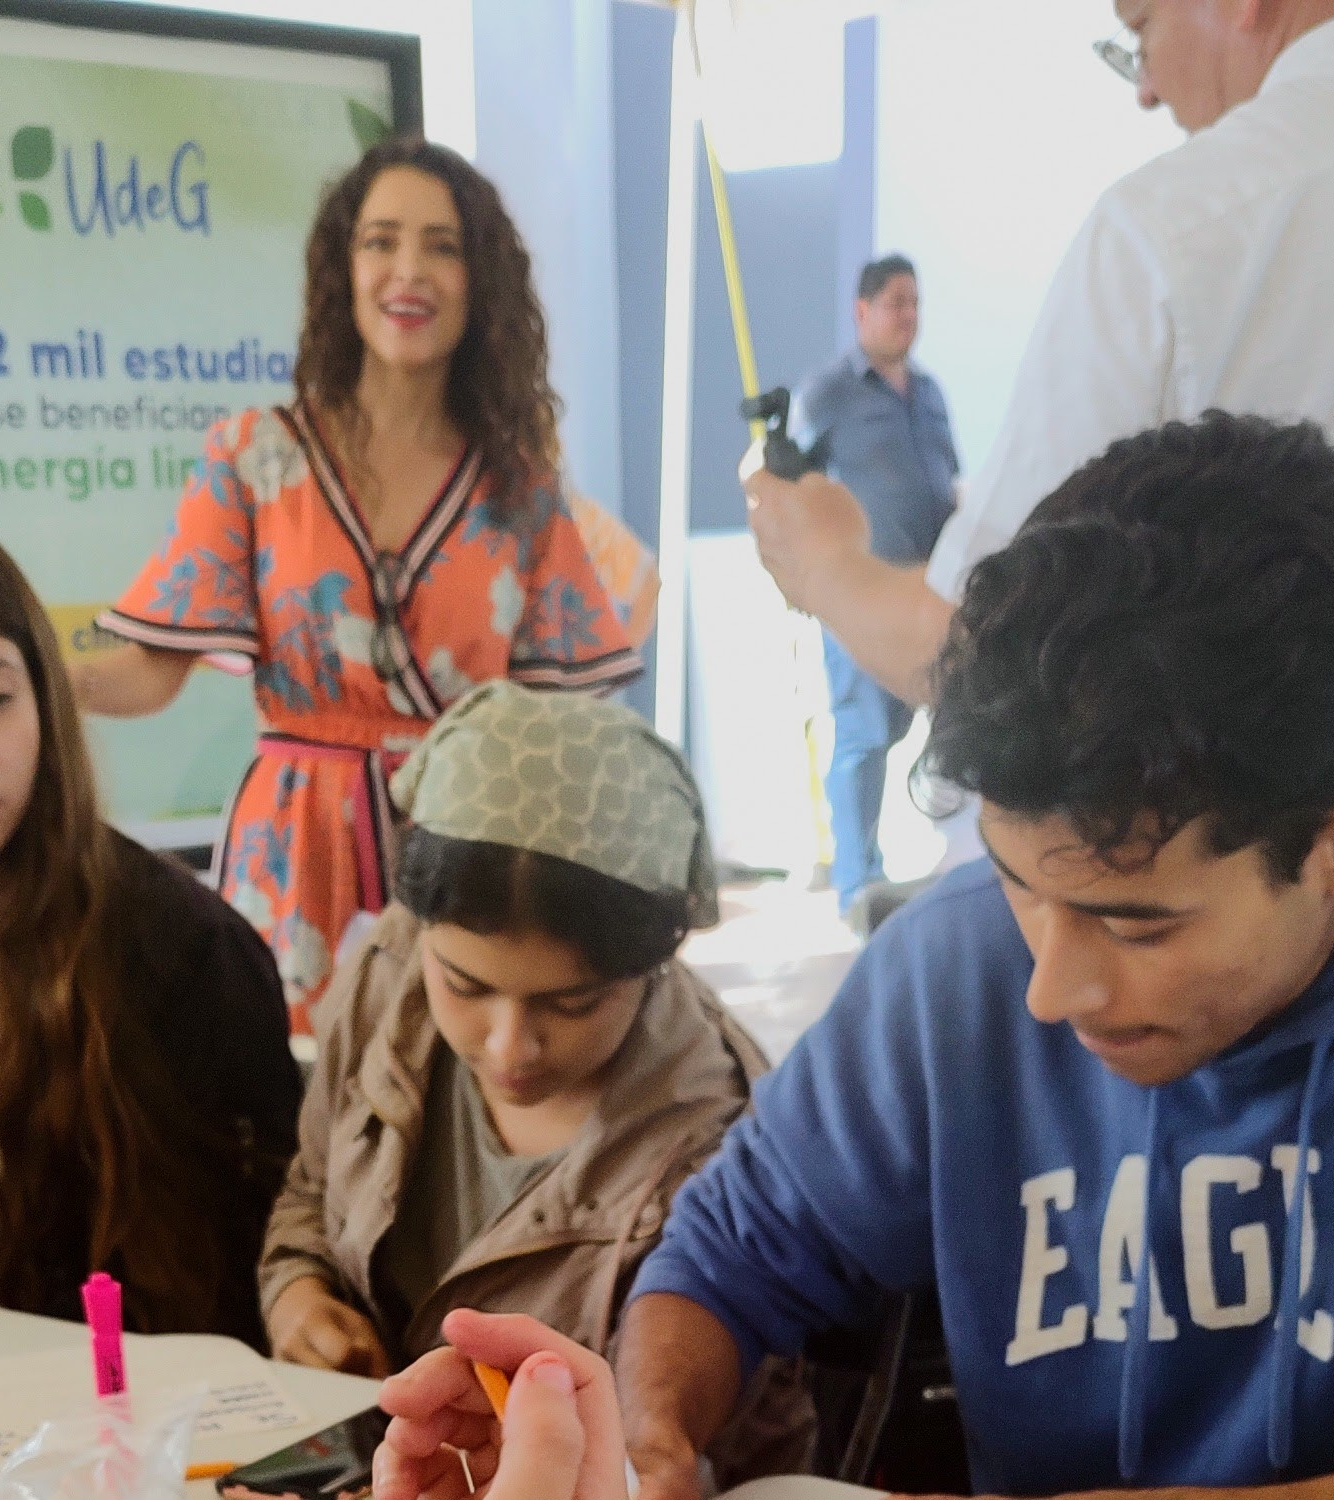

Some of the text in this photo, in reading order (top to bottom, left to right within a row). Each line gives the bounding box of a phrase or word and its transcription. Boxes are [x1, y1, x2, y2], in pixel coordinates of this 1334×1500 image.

[65, 140, 212, 238] UdeG
[30, 328, 106, 380] mil
[124, 338, 297, 385] estudia
